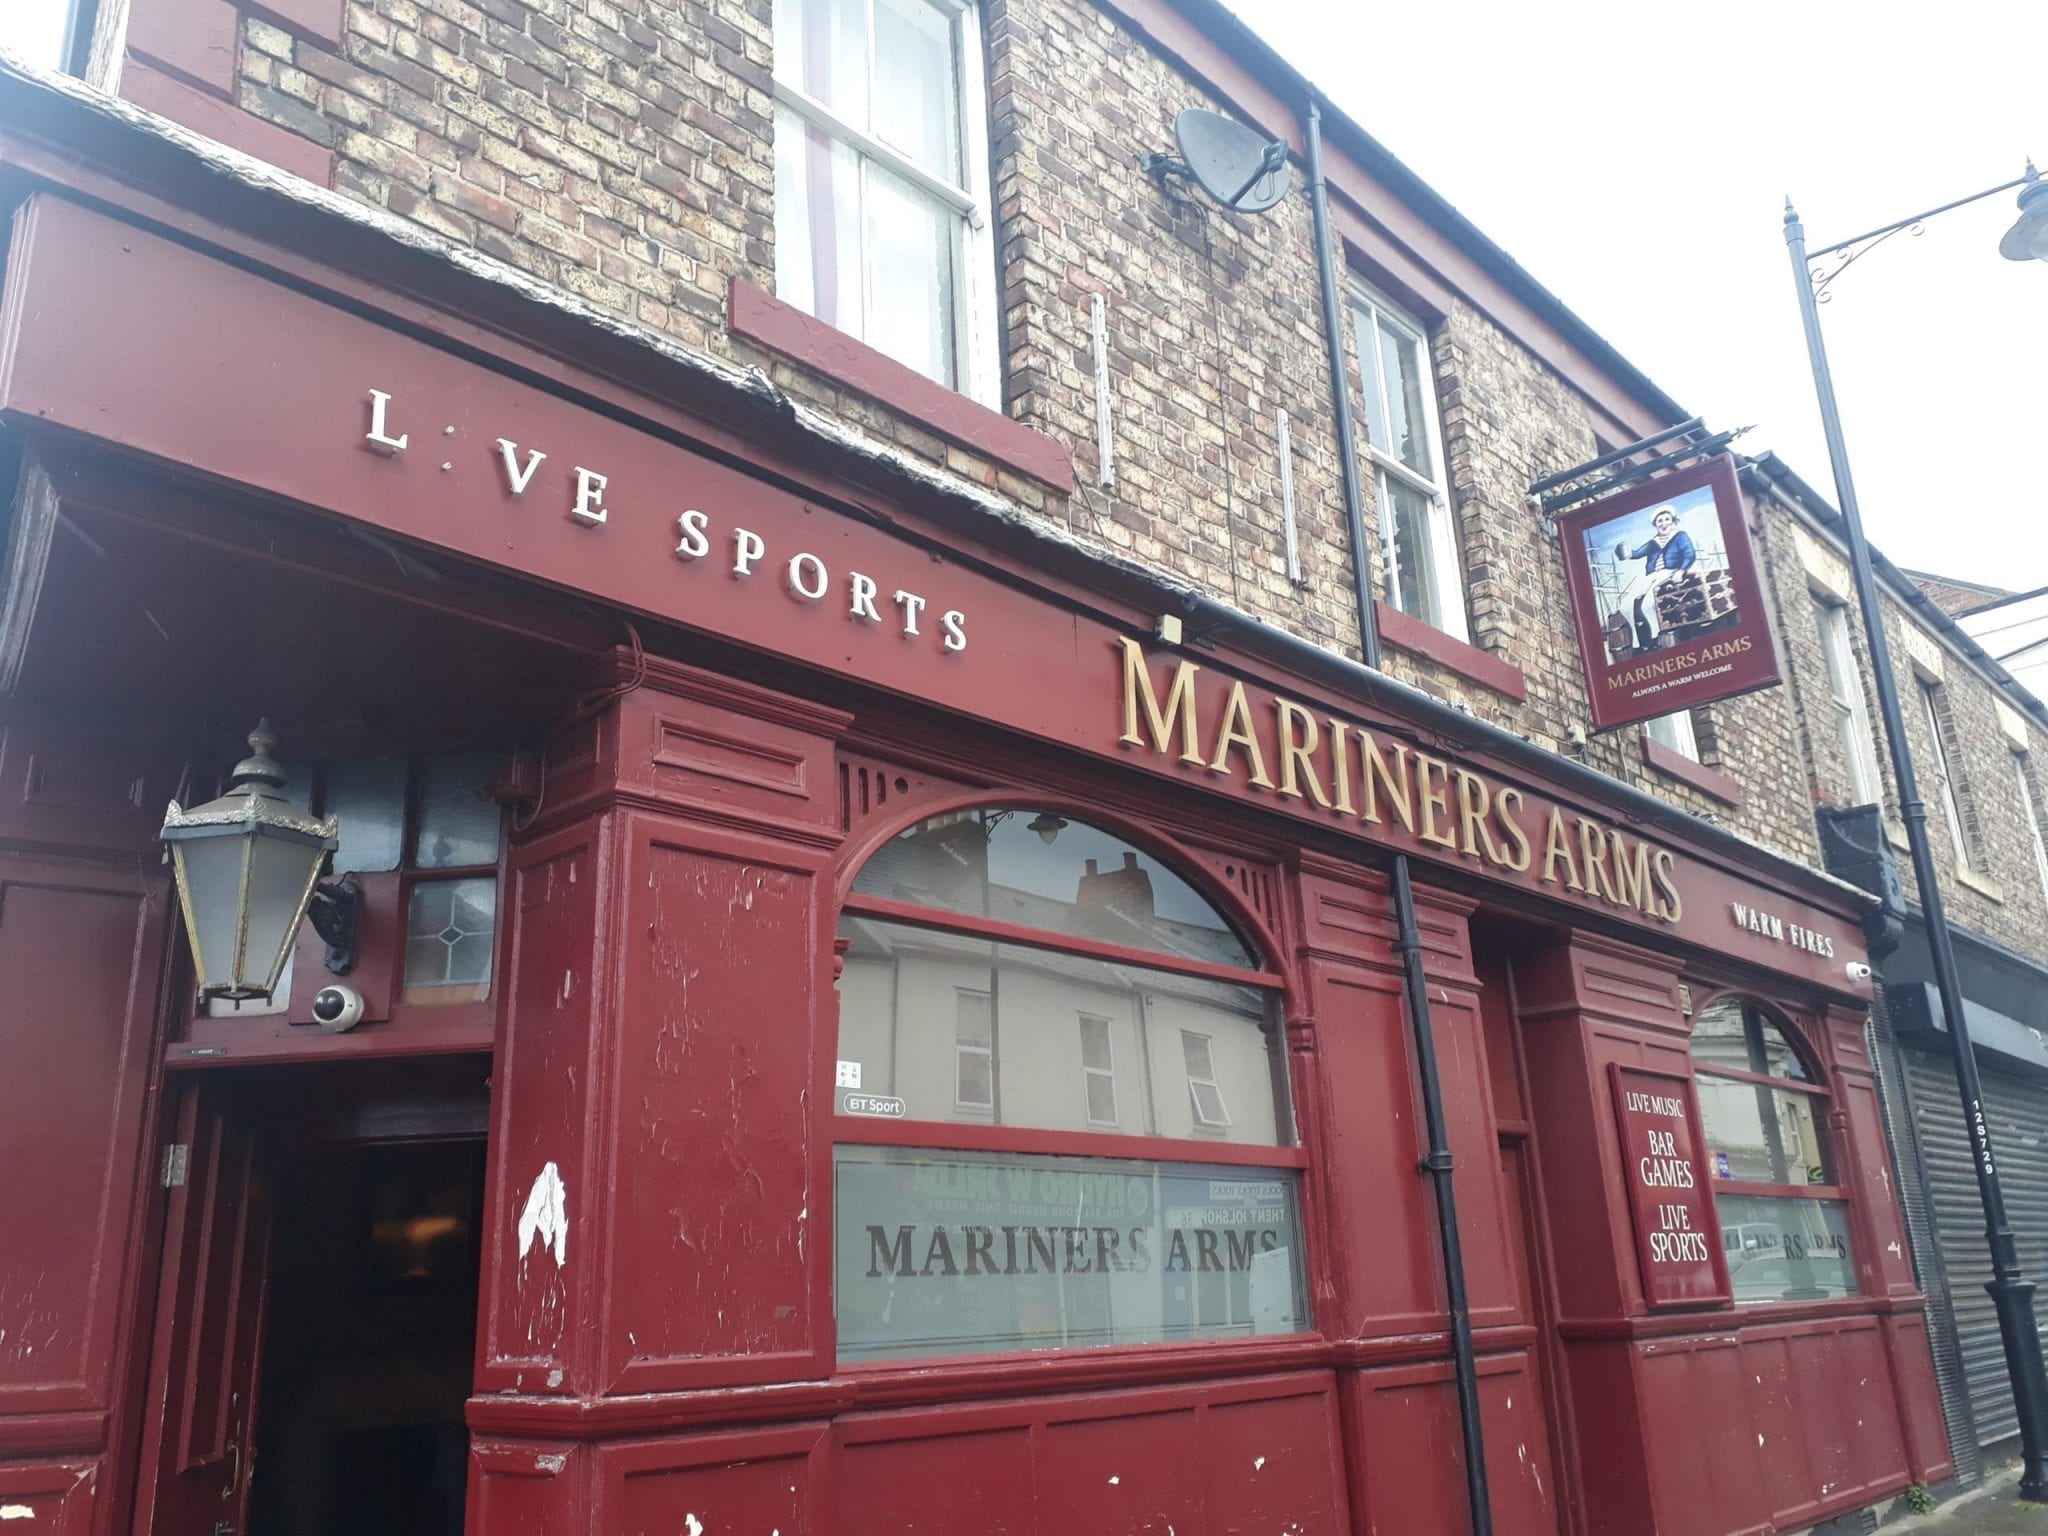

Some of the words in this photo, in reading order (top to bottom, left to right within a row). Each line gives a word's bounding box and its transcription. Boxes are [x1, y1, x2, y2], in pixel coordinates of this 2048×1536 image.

[366, 388, 608, 525] LVE
[675, 509, 968, 653] SPORTS
[1607, 652, 1697, 690] MARINERS
[1700, 635, 1752, 663] ARMS
[1632, 684, 1661, 698] ALWAYS
[1668, 675, 1693, 688] WARM
[1693, 664, 1734, 681] WELCOME
[1119, 635, 1531, 872] MARINERS
[1541, 805, 1682, 923] ARMS
[1730, 902, 1784, 940] WARM
[1789, 923, 1834, 958] FIRES
[850, 1099, 868, 1110] BT
[869, 1098, 900, 1113] Sport
[1626, 1091, 1651, 1112] LIVE
[1651, 1096, 1684, 1117] MUSIC
[1648, 1130, 1677, 1157] BAR
[1640, 1158, 1694, 1188] GAMES
[1659, 1205, 1690, 1230] LIVE
[865, 1224, 1152, 1278] MARINERS
[1650, 1232, 1708, 1262] SPORTS
